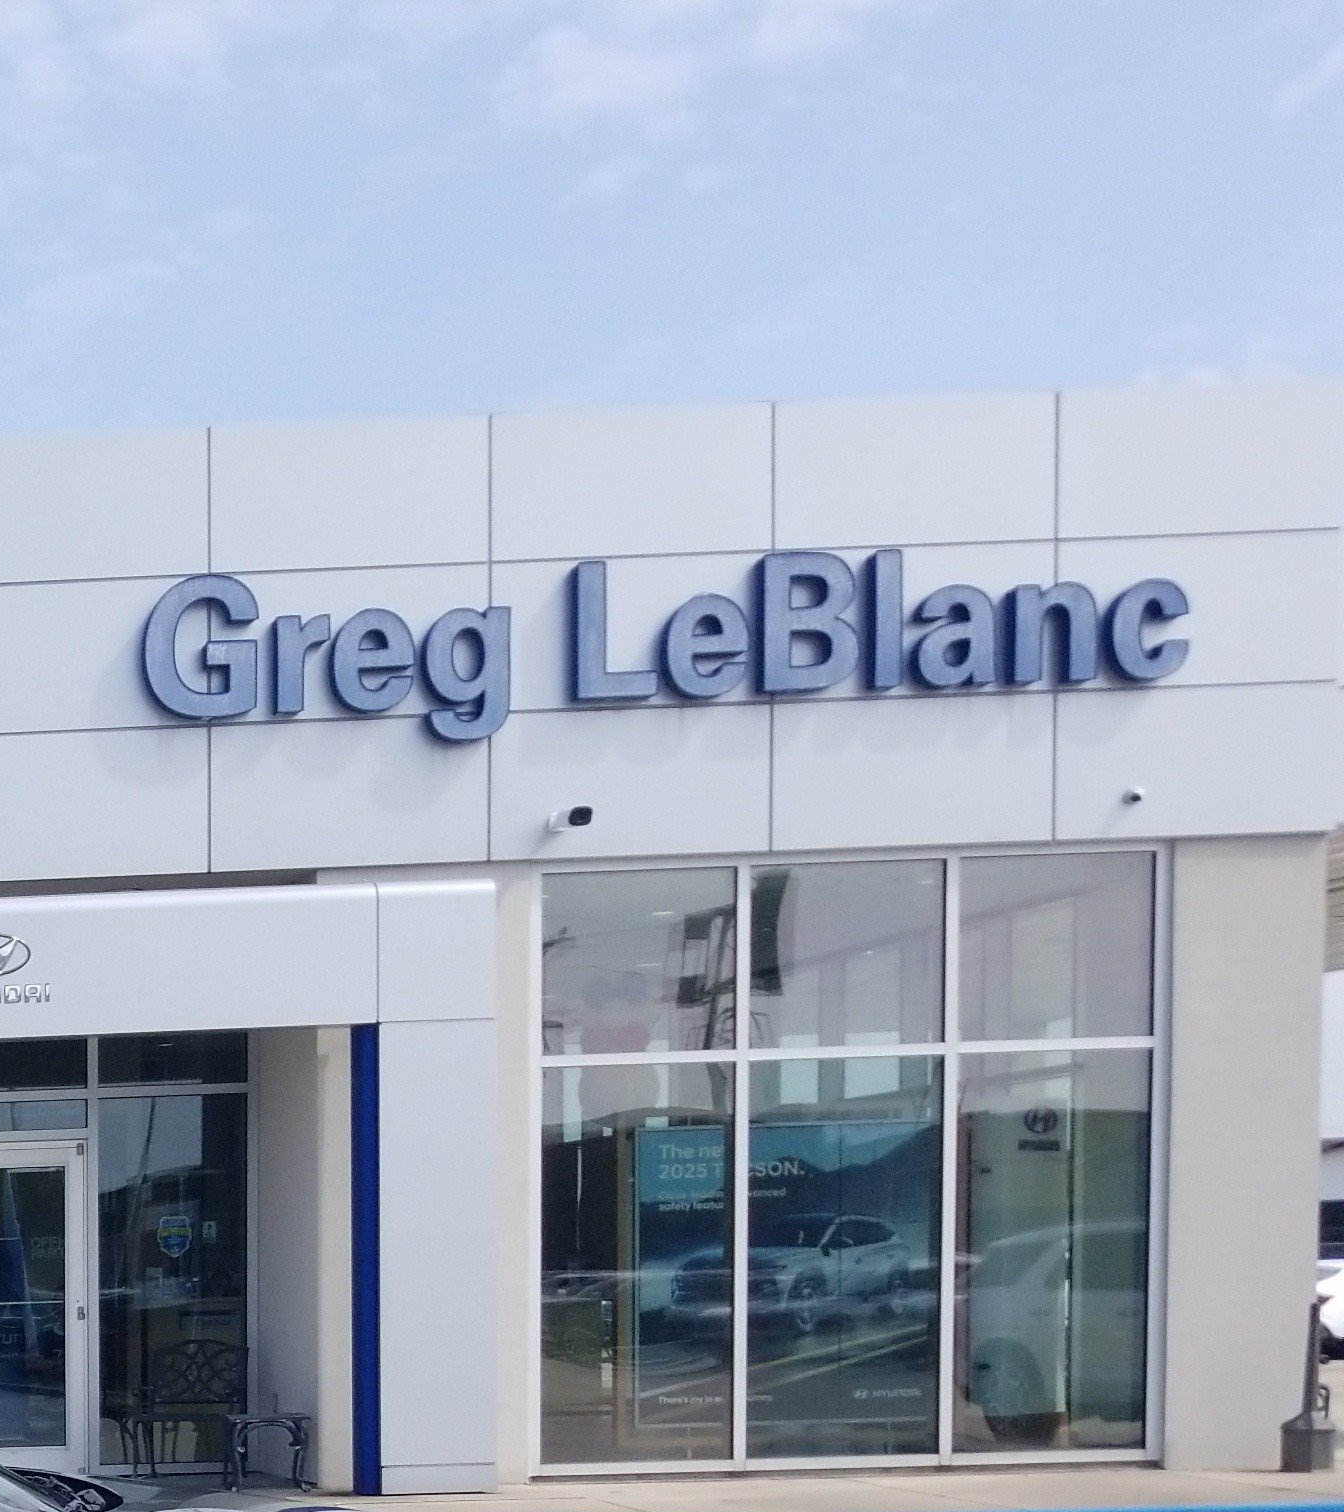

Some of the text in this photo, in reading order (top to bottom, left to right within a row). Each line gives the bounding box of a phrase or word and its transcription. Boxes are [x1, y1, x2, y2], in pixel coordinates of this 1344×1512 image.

[140, 548, 1190, 744] Greg LeBlanc
[659, 1145, 725, 1159] The ne
[659, 1163, 707, 1179] 2025
